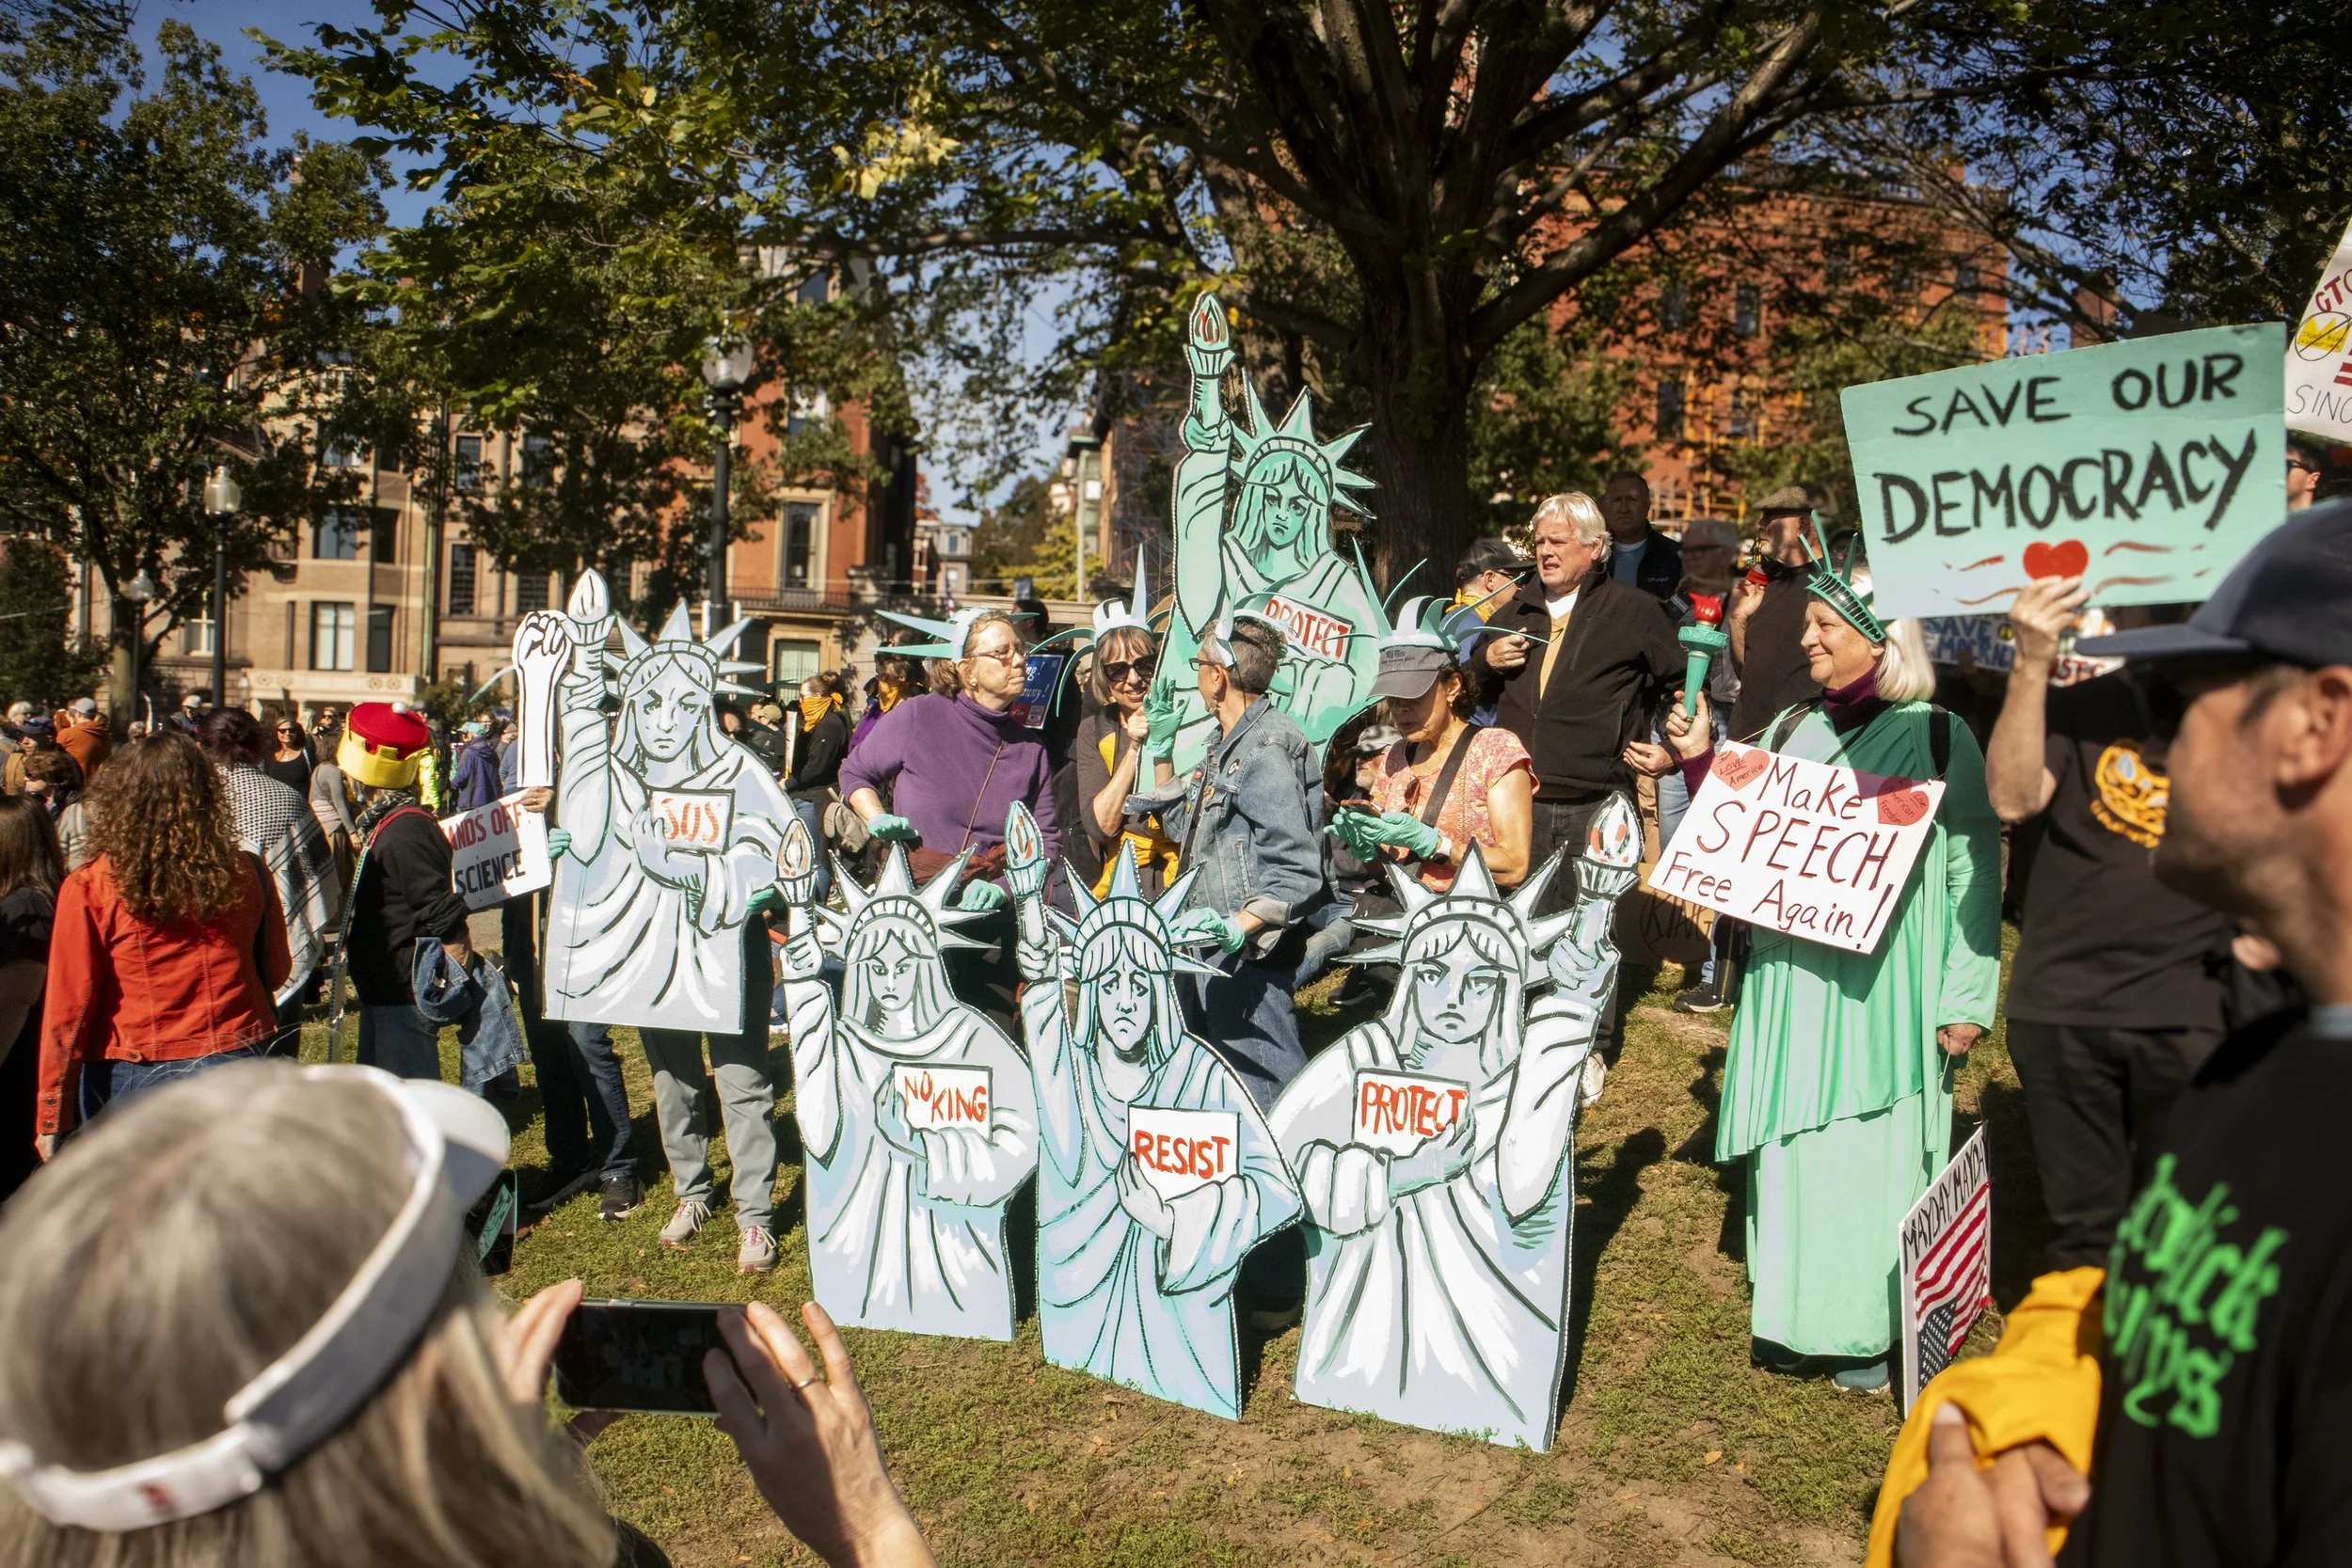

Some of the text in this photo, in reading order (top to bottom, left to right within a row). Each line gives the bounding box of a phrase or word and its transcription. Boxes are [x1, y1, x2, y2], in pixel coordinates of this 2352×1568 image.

[1892, 353, 2244, 436] SAVE OUR
[1871, 428, 2256, 545] DEMOCRACY
[1719, 758, 1747, 776] LOVE
[1729, 764, 1764, 787] America
[1756, 756, 1864, 820] Make
[443, 800, 522, 851] ANDS OFF
[660, 798, 722, 845] SOS
[1696, 800, 1899, 891] SPEECH
[454, 848, 526, 896] SCIENCE
[1662, 850, 1894, 950] Free Again!
[904, 1070, 987, 1124] NO KING
[1361, 1082, 1469, 1136] PROTECT
[1135, 1130, 1230, 1180] RESIST
